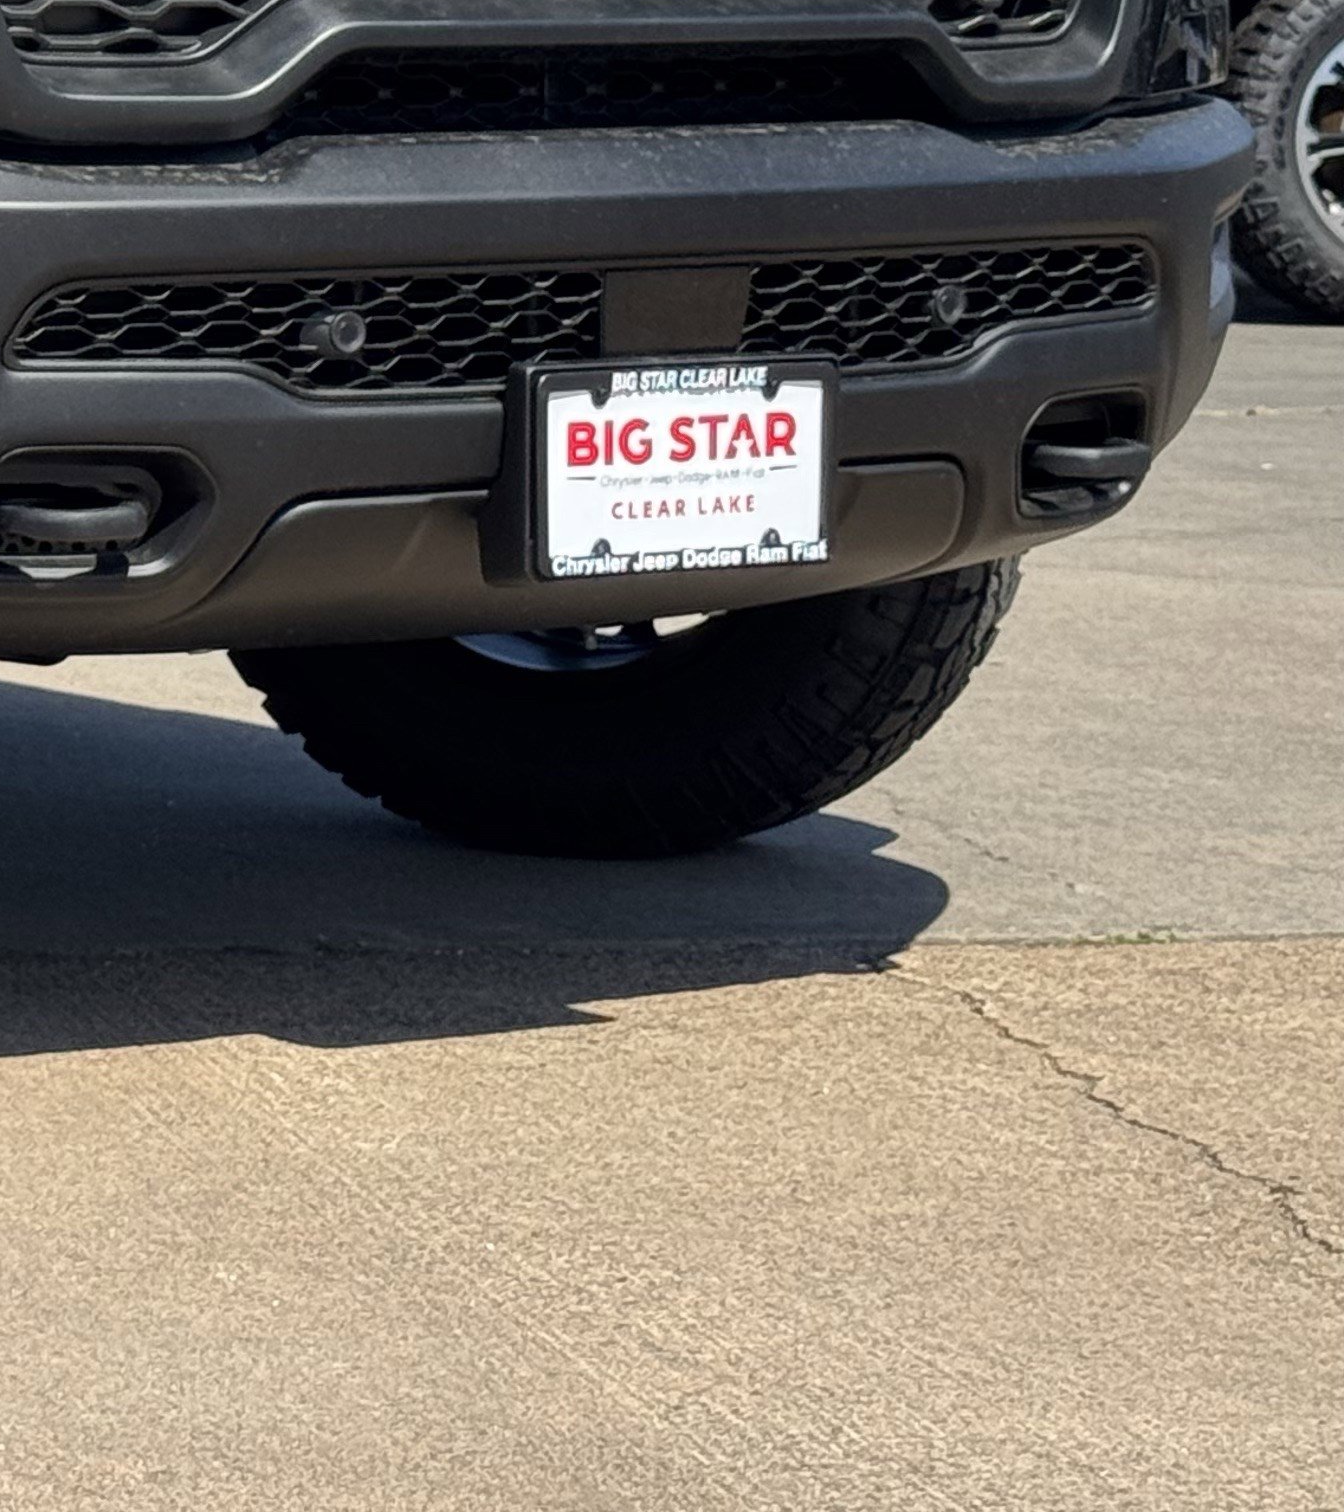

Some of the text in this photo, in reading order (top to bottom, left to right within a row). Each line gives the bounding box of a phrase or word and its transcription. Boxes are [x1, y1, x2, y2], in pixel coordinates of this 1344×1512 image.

[612, 366, 768, 390] BIG STAR CLEAR LAKE
[567, 412, 797, 467] BIG STAR
[611, 494, 755, 519] CLEAR LAKE
[552, 539, 829, 577] Chrysler Jeep Dodge Ram Fiat
